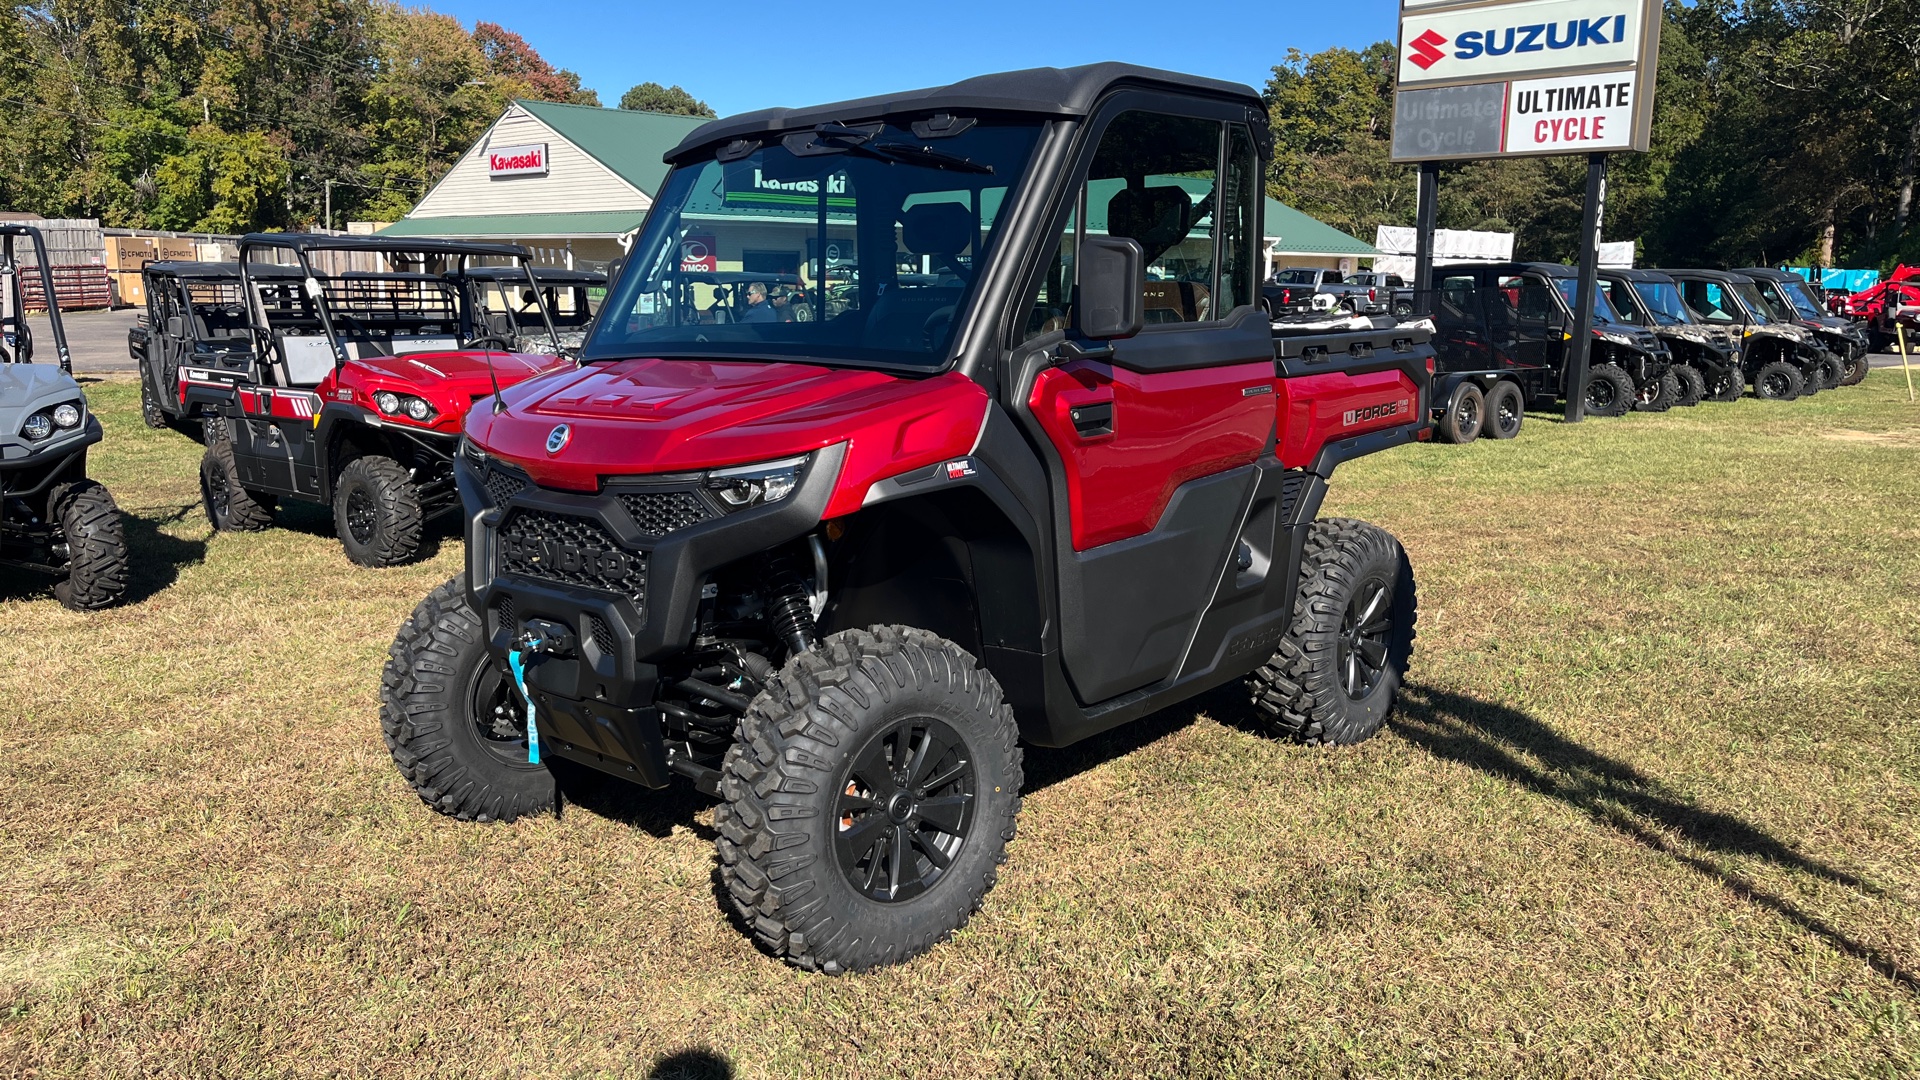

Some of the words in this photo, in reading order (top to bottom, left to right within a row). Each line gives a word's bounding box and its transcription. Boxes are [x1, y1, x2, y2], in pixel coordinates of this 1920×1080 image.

[1454, 14, 1626, 60] SUZUKI
[1402, 96, 1498, 122] Ultimate
[1517, 82, 1631, 115] ULTIMATE
[1417, 126, 1476, 152] Cycle
[1534, 116, 1607, 144] CYCLE
[490, 150, 542, 171] Kawasaki
[127, 250, 153, 258] CFMOTO
[506, 534, 628, 580] CFMOTO
